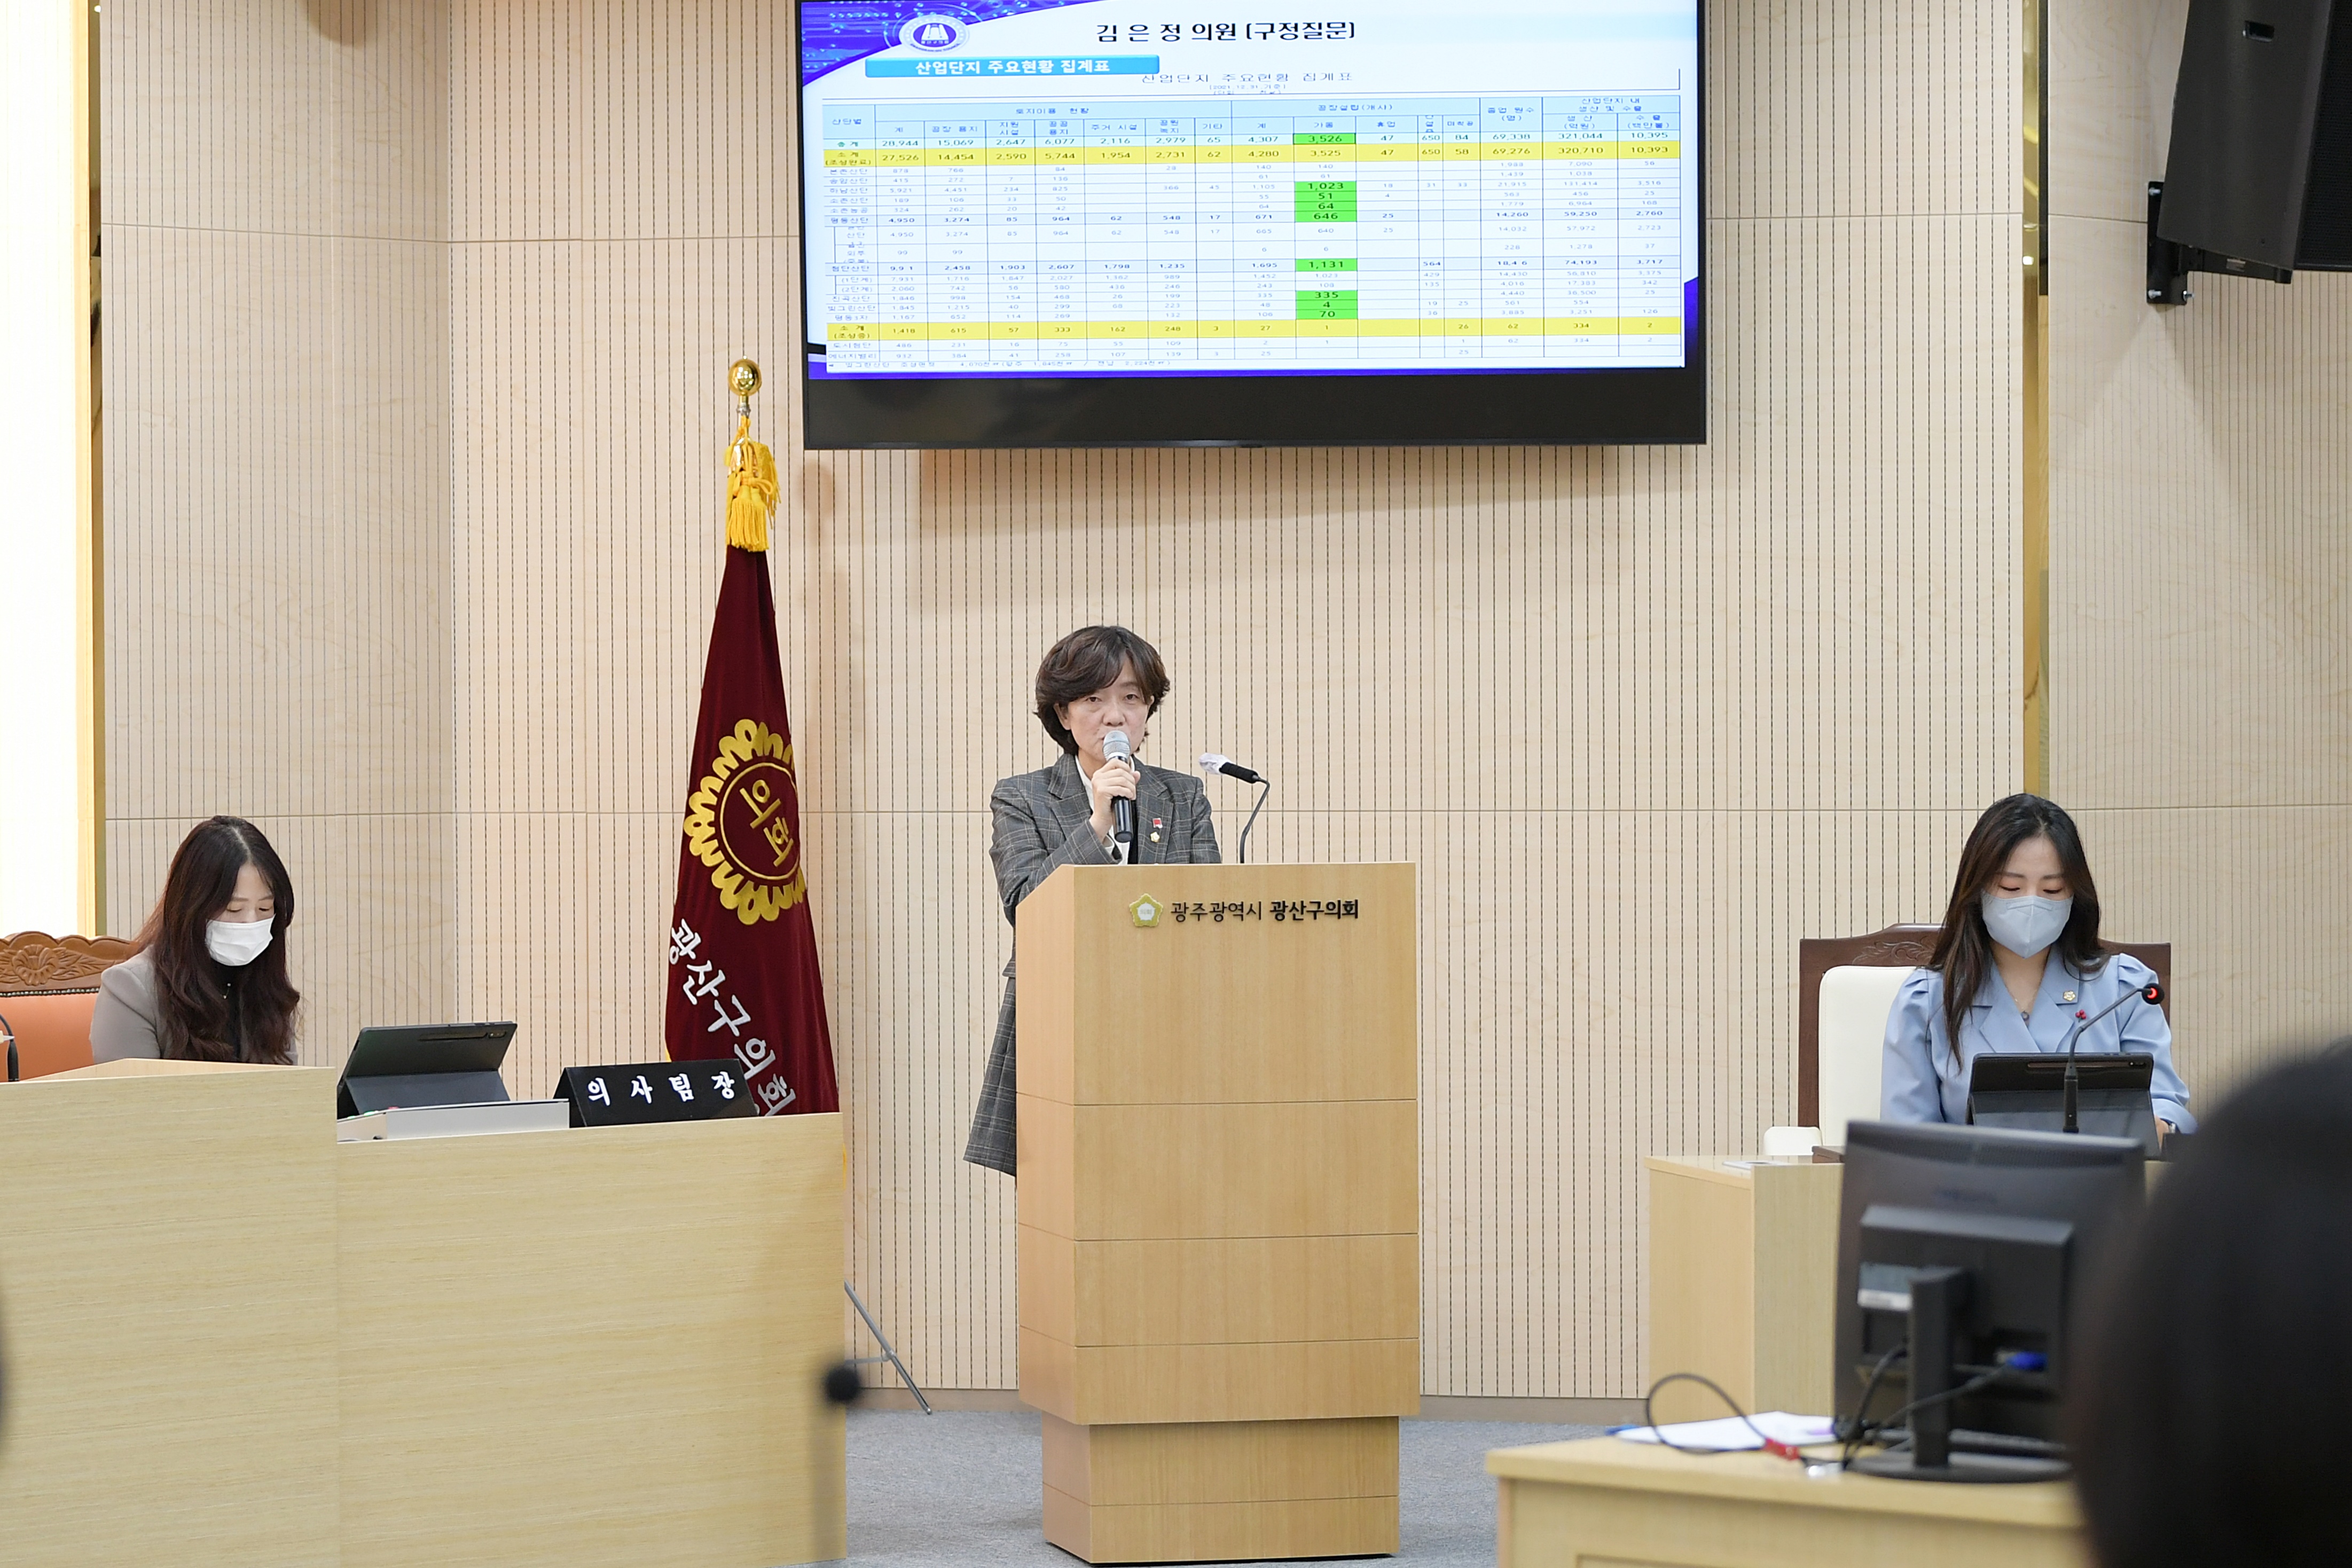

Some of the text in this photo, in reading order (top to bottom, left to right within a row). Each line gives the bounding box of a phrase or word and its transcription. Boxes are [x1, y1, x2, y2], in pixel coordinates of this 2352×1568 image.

[1192, 23, 1236, 41] 의원
[915, 60, 1110, 75] 산업단지 주요현황 집계표
[1141, 73, 1208, 83] 산업단지
[739, 779, 794, 867] 의회
[1171, 899, 1359, 922] 광주광역시 광산구의회
[669, 918, 796, 1117] 광산구의회
